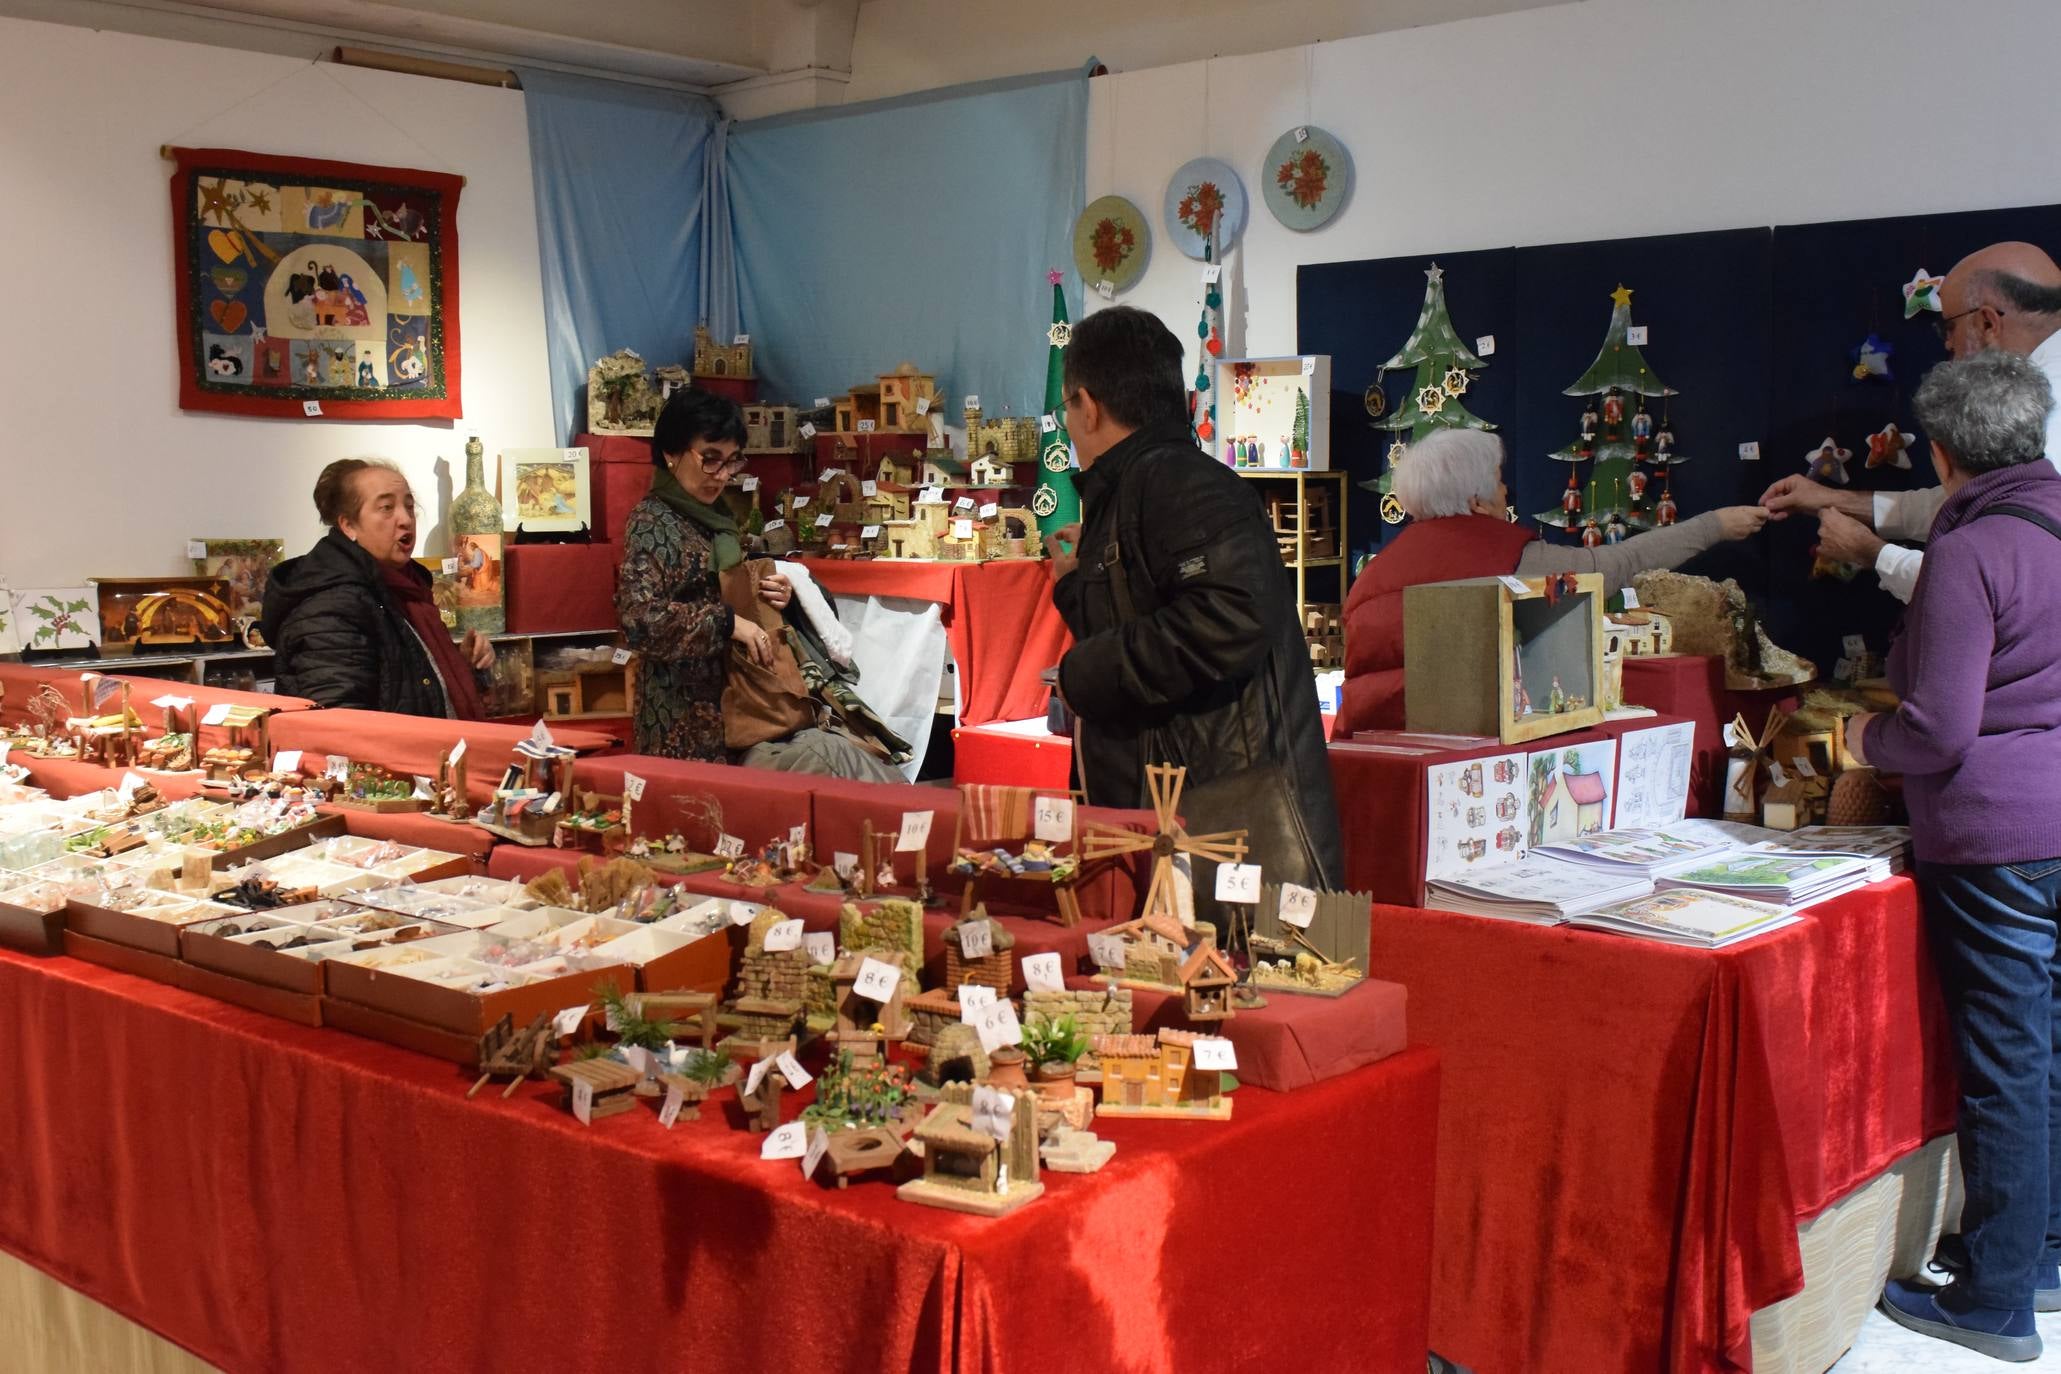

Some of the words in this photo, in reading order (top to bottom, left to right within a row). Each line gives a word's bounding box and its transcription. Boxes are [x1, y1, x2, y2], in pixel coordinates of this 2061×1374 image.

[1039, 809, 1051, 823] 15
[1056, 811, 1064, 824] €
[907, 823, 918, 835] 10
[920, 822, 927, 835] €
[1227, 876, 1236, 889] 5
[1241, 876, 1248, 890] €
[1289, 892, 1298, 904] 8
[1301, 895, 1309, 907] €
[774, 927, 782, 937] 8
[786, 926, 793, 937] €
[966, 934, 979, 948] 10
[981, 932, 988, 946] €
[822, 944, 829, 957] €
[1033, 962, 1041, 977] 8
[1045, 960, 1054, 975] €
[865, 972, 875, 985] 8
[879, 975, 888, 988] €
[967, 995, 976, 1008] 6
[979, 995, 987, 1009] €
[985, 1015, 994, 1030] 6
[997, 1010, 1007, 1025] €
[1203, 1049, 1211, 1060] 7
[1217, 1049, 1225, 1061] €
